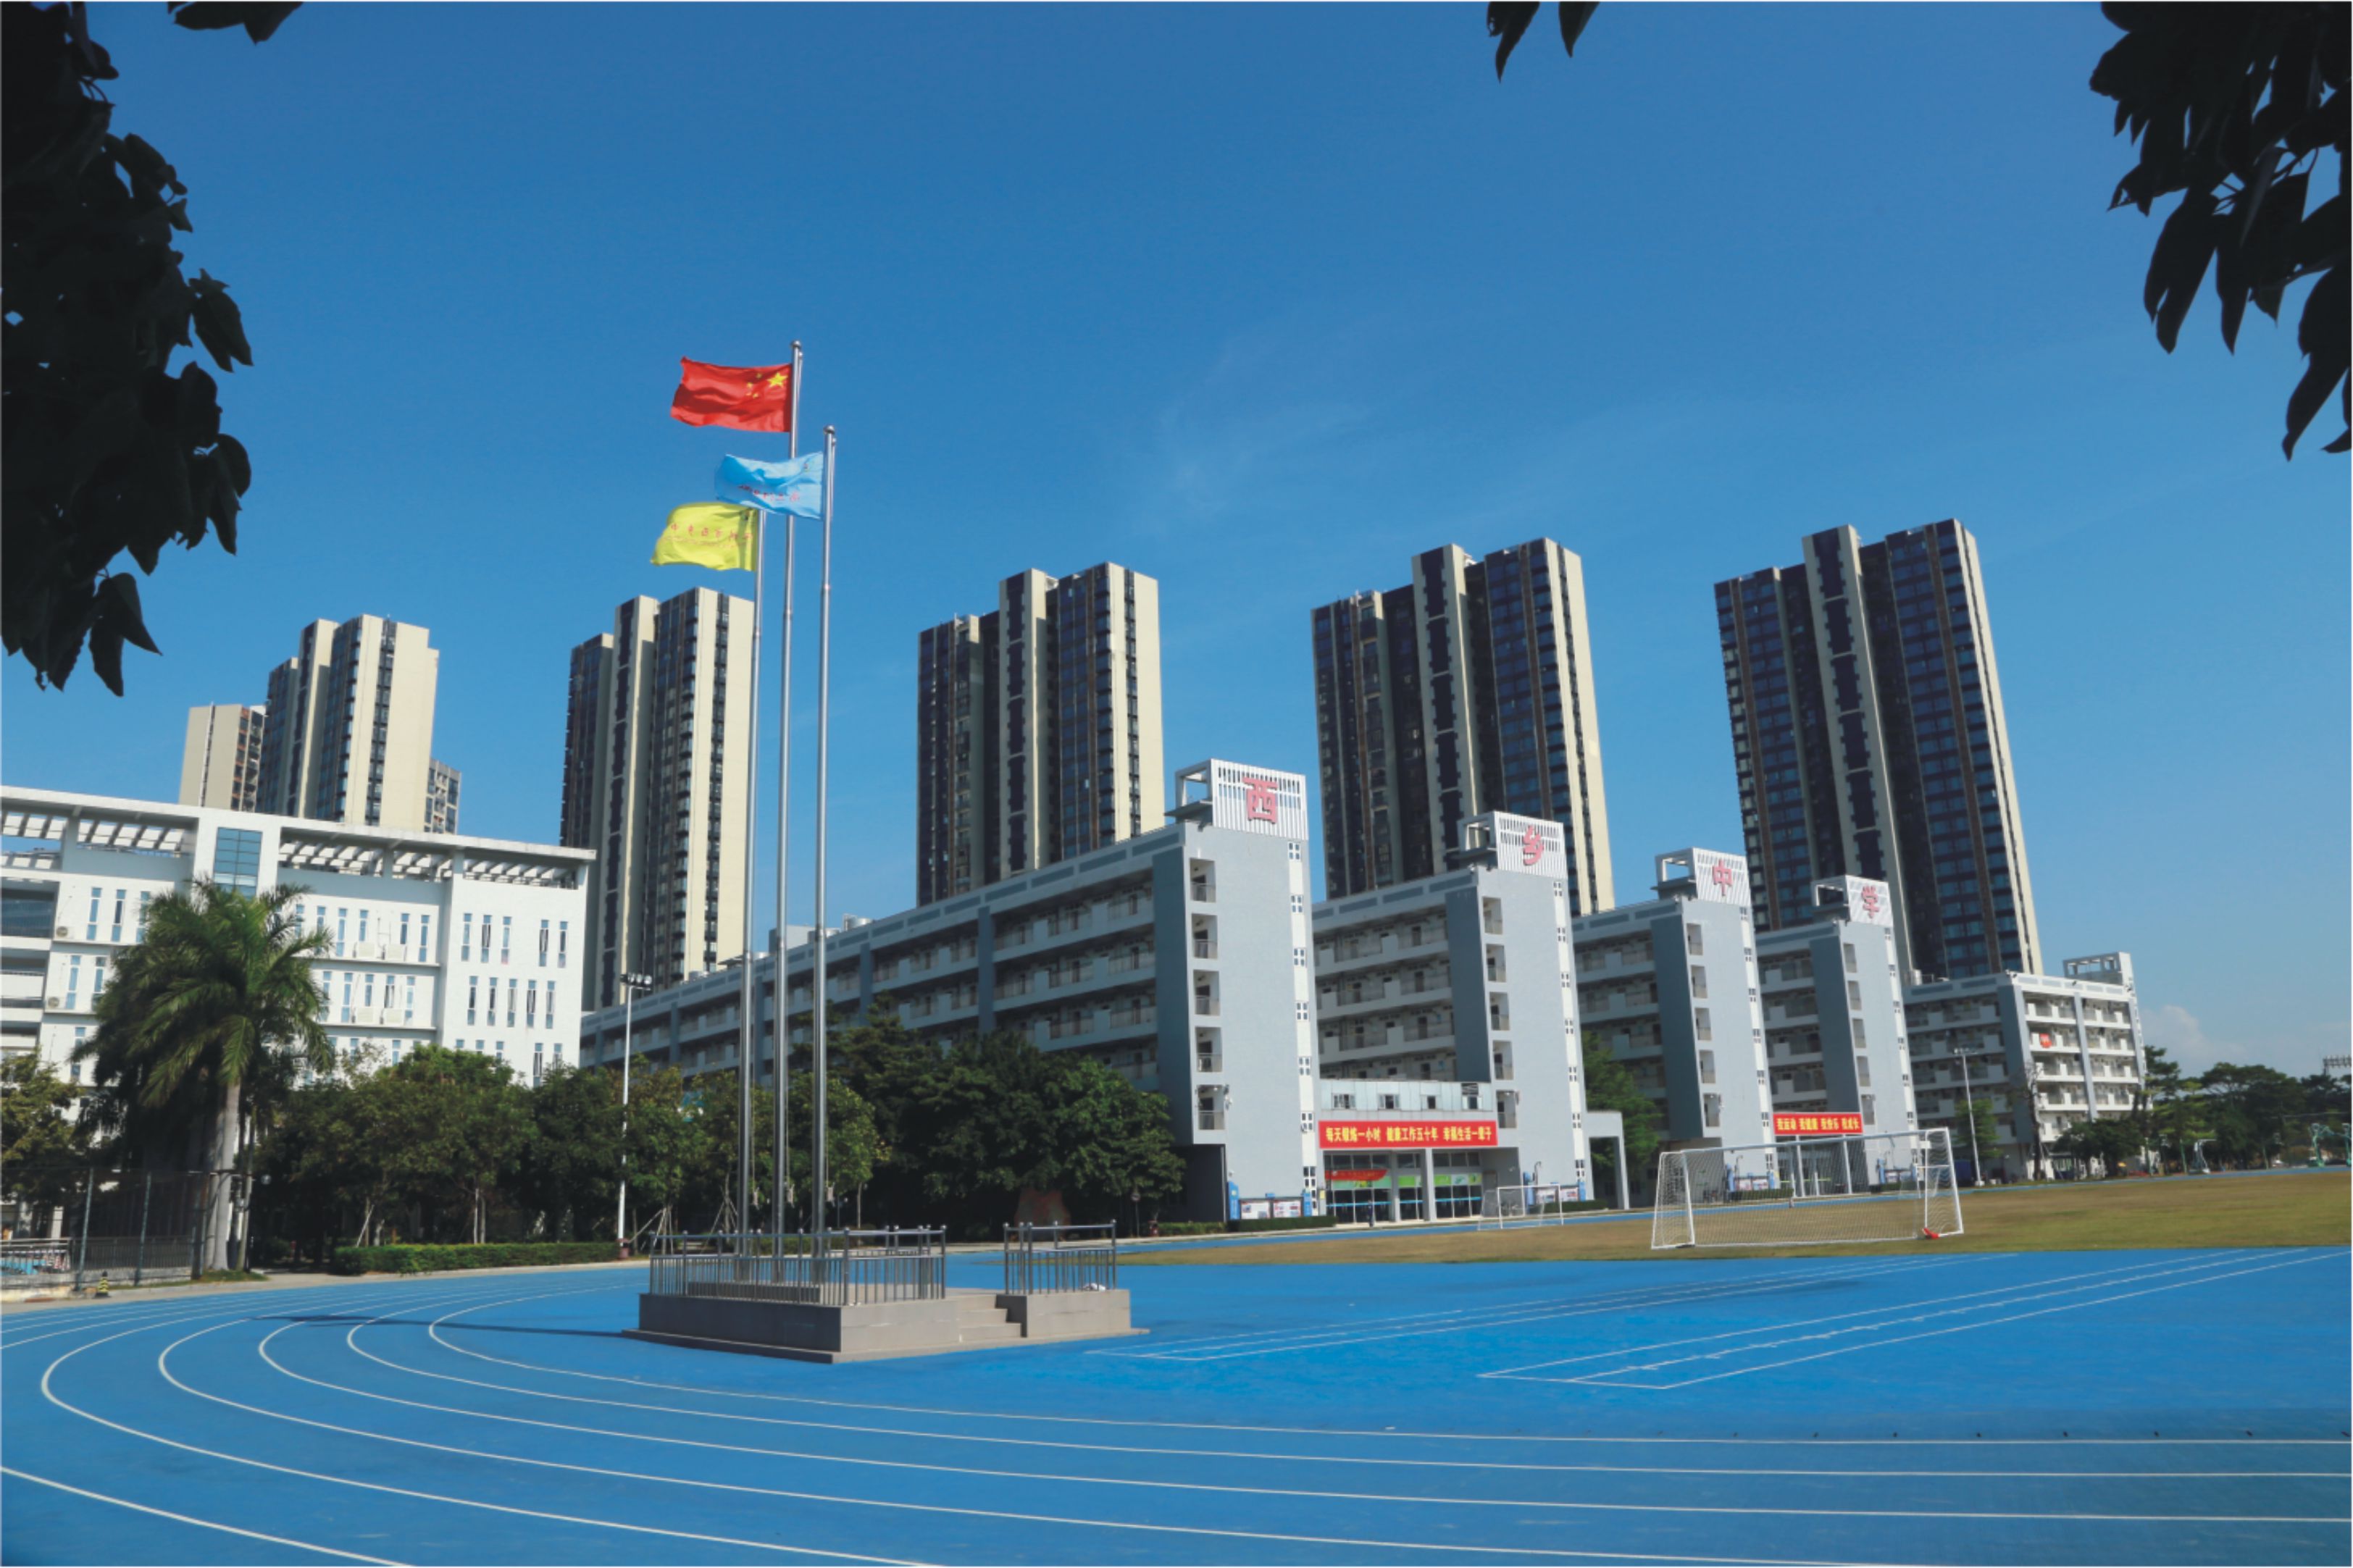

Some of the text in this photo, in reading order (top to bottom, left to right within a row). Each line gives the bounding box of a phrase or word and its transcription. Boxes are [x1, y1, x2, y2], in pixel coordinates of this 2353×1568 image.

[1242, 776, 1278, 823] 西
[1522, 825, 1544, 866] 乡
[1712, 859, 1733, 897] 中
[1861, 884, 1879, 919] 学
[1326, 1125, 1492, 1143] 每天锻炼一小时 健康工作五十年 幸福生活一辈子
